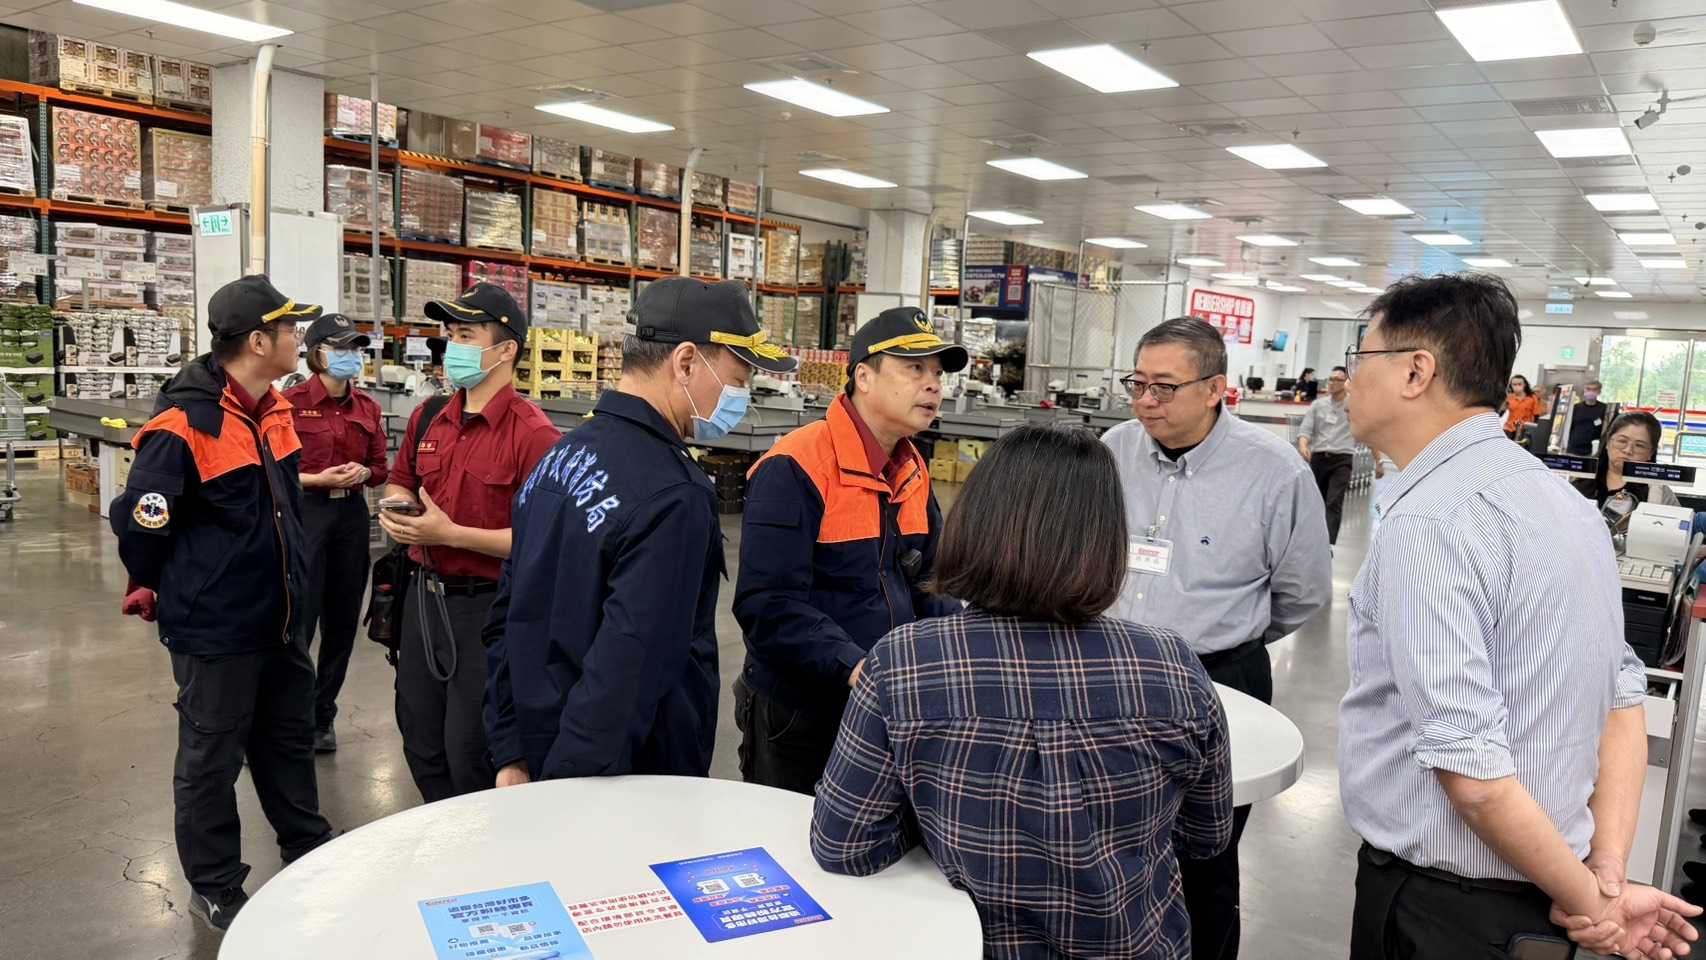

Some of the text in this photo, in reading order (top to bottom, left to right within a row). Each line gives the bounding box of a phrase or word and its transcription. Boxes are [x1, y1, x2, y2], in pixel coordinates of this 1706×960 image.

[145, 495, 163, 503] EMT
[582, 911, 683, 933] 店內請勿使用免洗餐具
